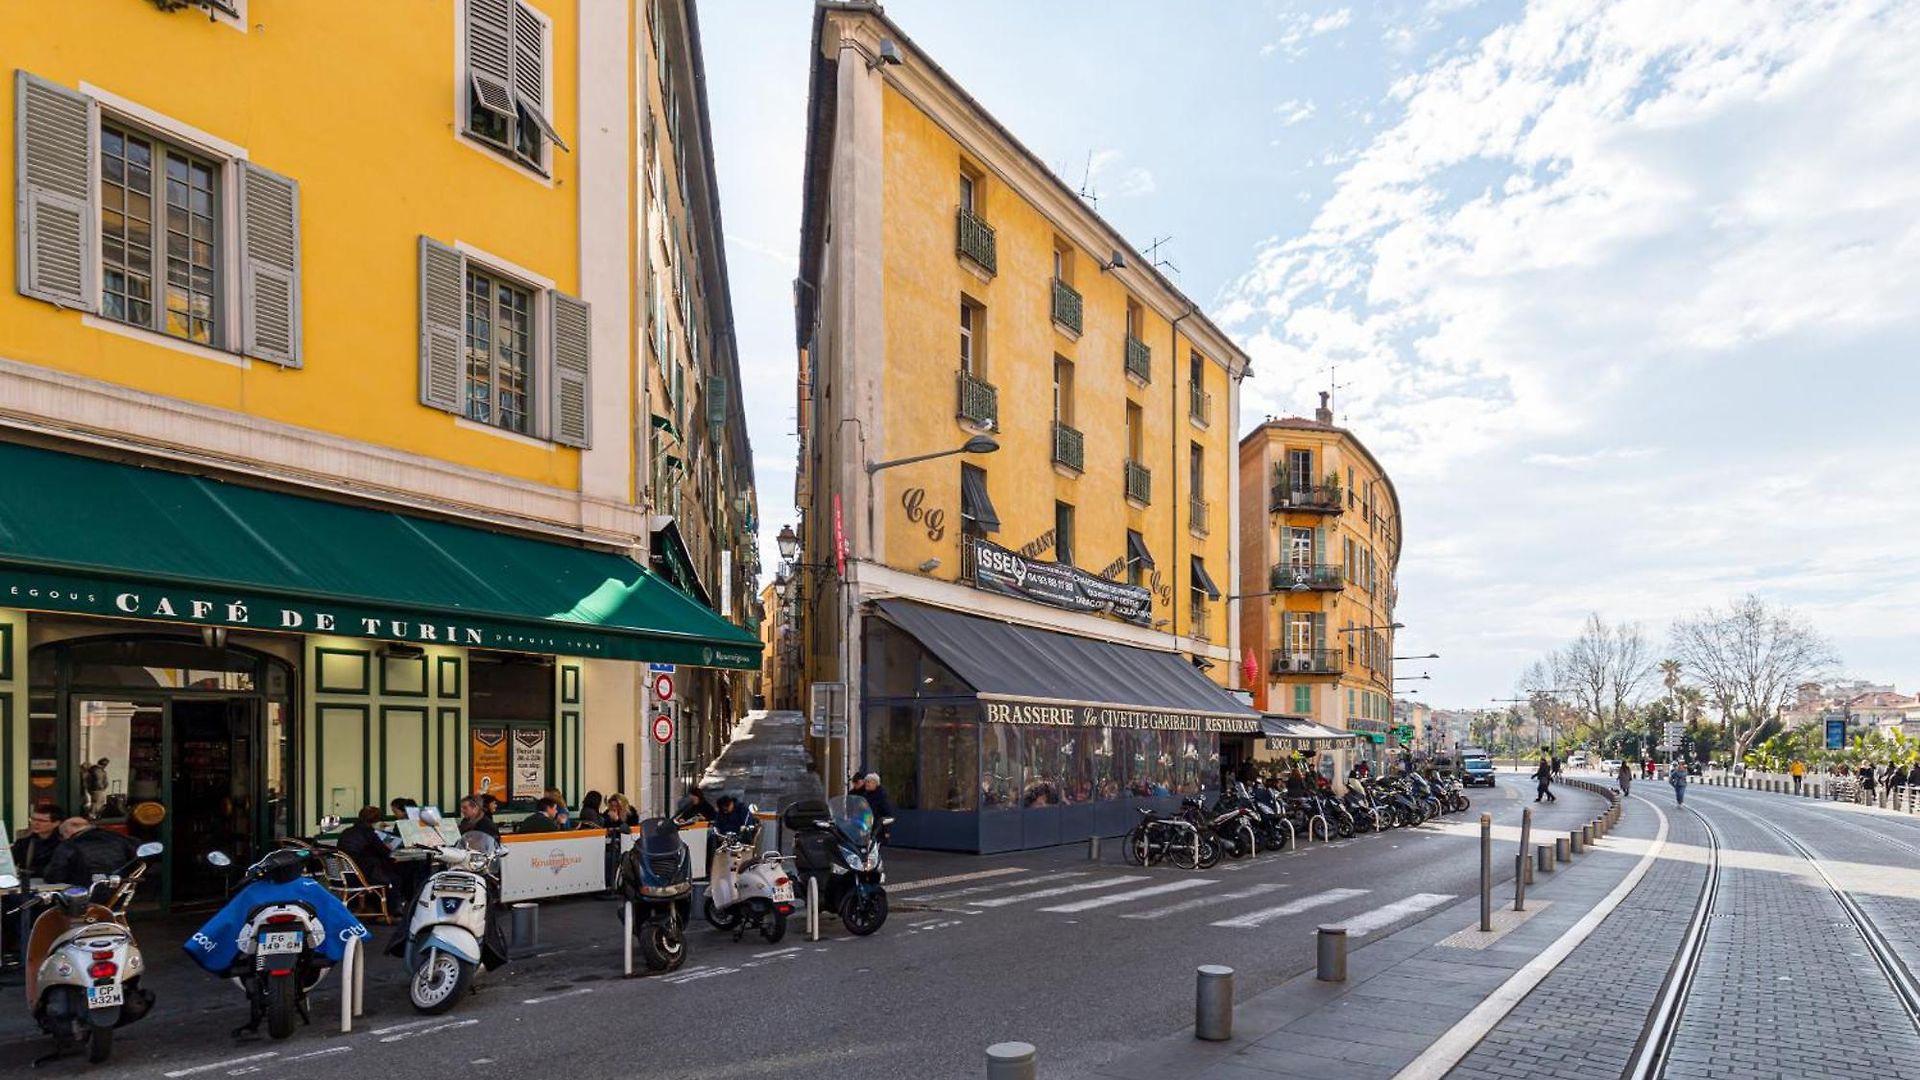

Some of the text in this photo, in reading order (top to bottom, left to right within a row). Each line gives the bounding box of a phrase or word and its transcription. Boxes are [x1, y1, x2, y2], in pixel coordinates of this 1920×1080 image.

[116, 593, 248, 623] CAFÉ
[280, 609, 335, 631] DE
[361, 618, 482, 644] TURIN
[496, 635, 553, 646] DEPUIS
[987, 704, 1074, 725] BRASSERIE
[1101, 710, 1149, 728] CIVETTE
[1150, 713, 1200, 731] GARIBALDI
[1205, 717, 1259, 732] RESTAURANT
